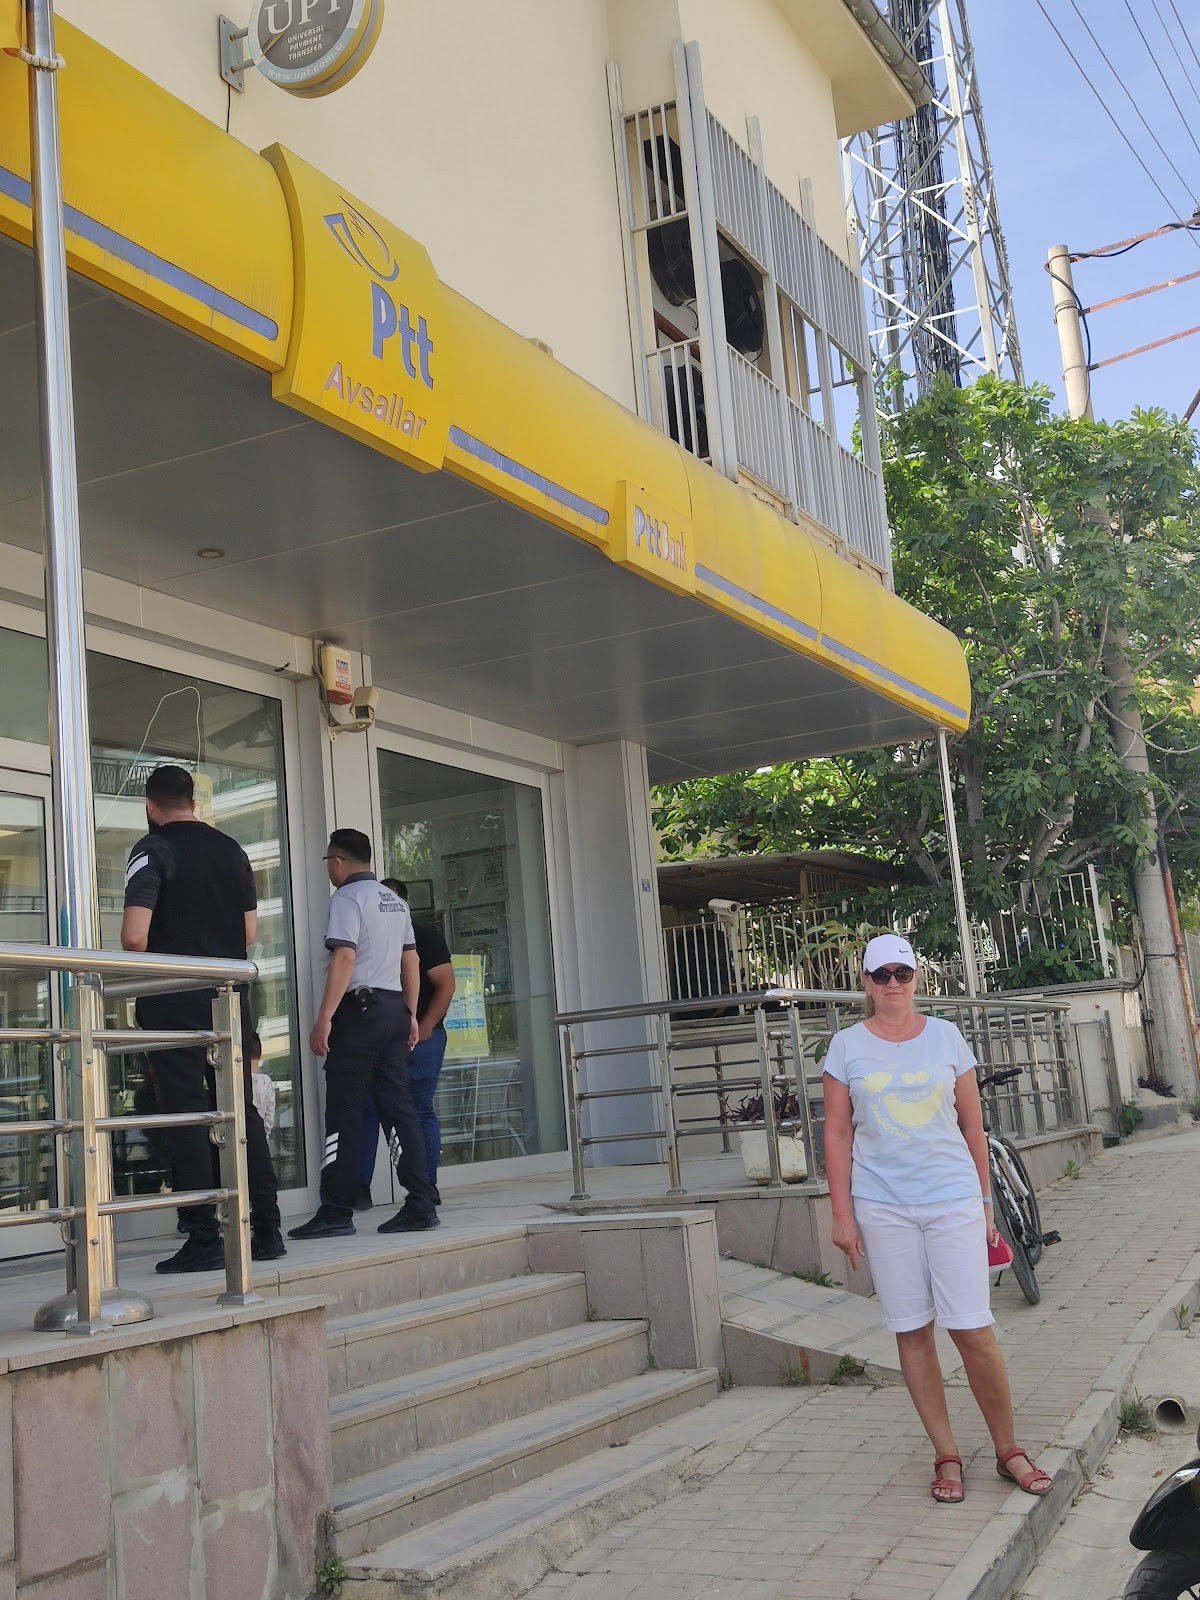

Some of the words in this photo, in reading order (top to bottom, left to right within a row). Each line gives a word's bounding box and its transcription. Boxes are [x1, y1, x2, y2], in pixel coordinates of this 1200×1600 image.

[287, 24, 325, 44] UNIVERSAL
[288, 43, 323, 61] TRANSFER
[289, 34, 322, 52] PAYMENT
[267, 42, 344, 80] www.upt.com.tr
[370, 279, 434, 390] Ptt
[323, 360, 427, 441] Avsallar
[634, 504, 688, 573] PttBank
